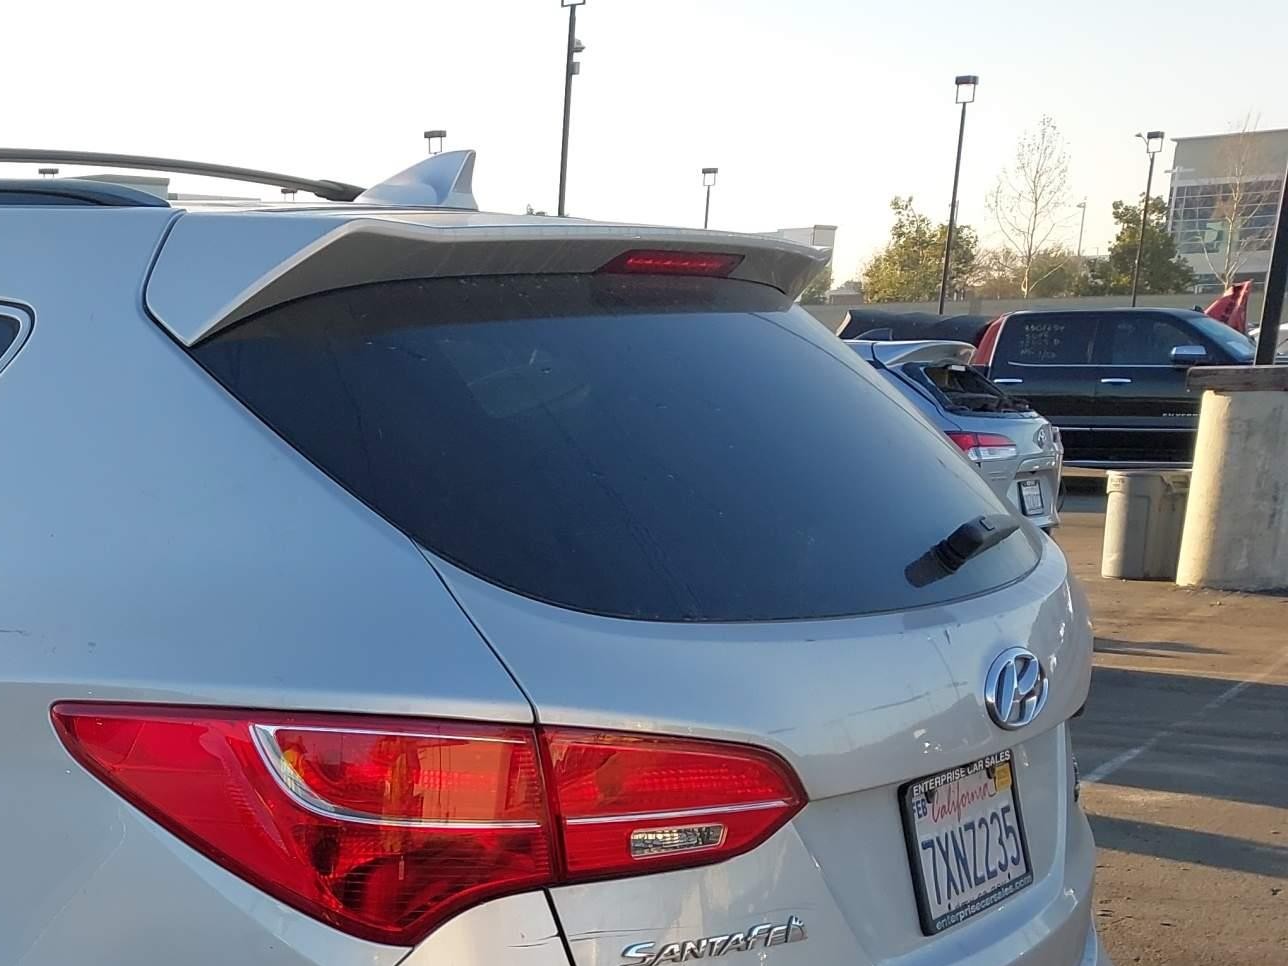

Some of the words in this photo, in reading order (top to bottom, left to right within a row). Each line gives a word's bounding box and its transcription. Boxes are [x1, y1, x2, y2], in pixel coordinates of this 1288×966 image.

[913, 767, 966, 798] ENTERPRISE
[984, 750, 1011, 769] SALES
[930, 780, 996, 823] California
[921, 806, 1021, 905] 7XNZ235
[935, 875, 1033, 931] enterprisecarsales.com
